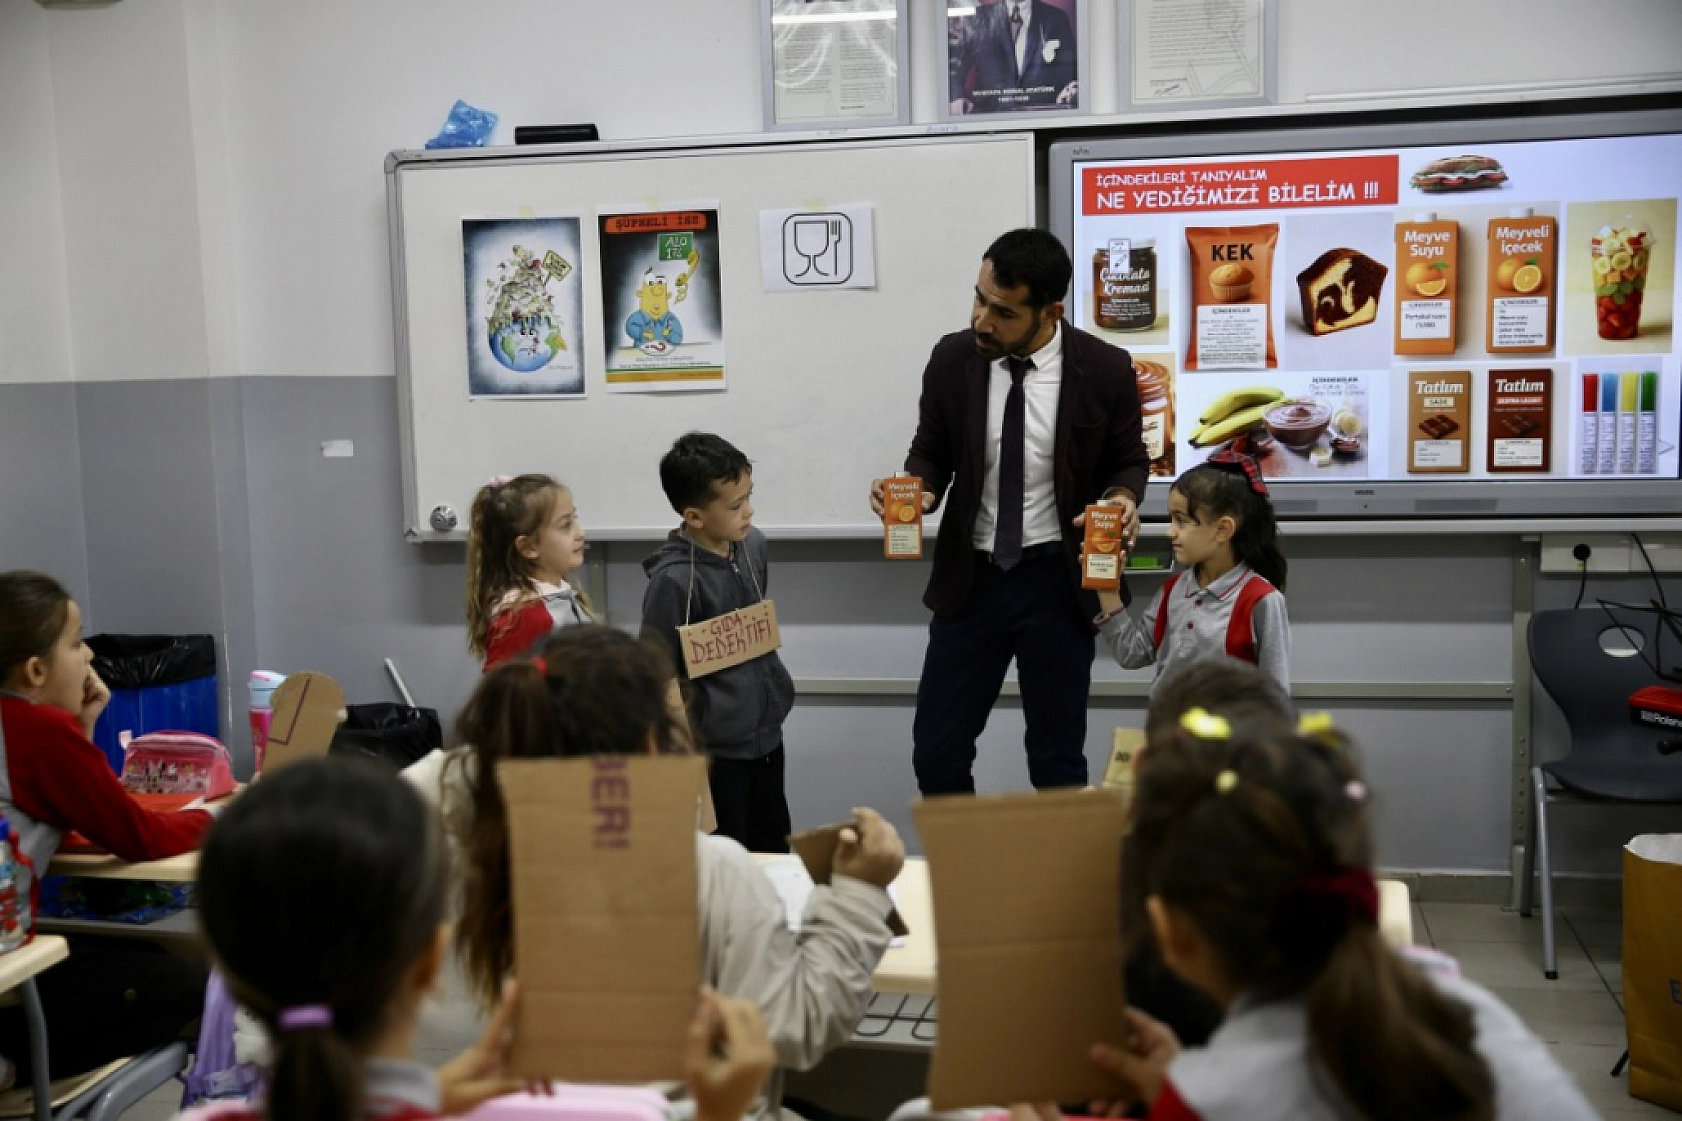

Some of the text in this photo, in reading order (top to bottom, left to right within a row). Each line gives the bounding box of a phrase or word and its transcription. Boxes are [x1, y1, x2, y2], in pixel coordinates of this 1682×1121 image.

[1096, 168, 1267, 188] İÇİNDEKİLERİ TANIYALIM
[1096, 191, 1126, 209] NE
[1133, 183, 1259, 208] YEDİĞİMİZİ
[1268, 180, 1356, 203] BİLELİM
[1404, 229, 1450, 244] Meyve
[1496, 225, 1549, 240] Meyveli
[1211, 243, 1254, 261] KEK
[1410, 244, 1444, 258] Suyu
